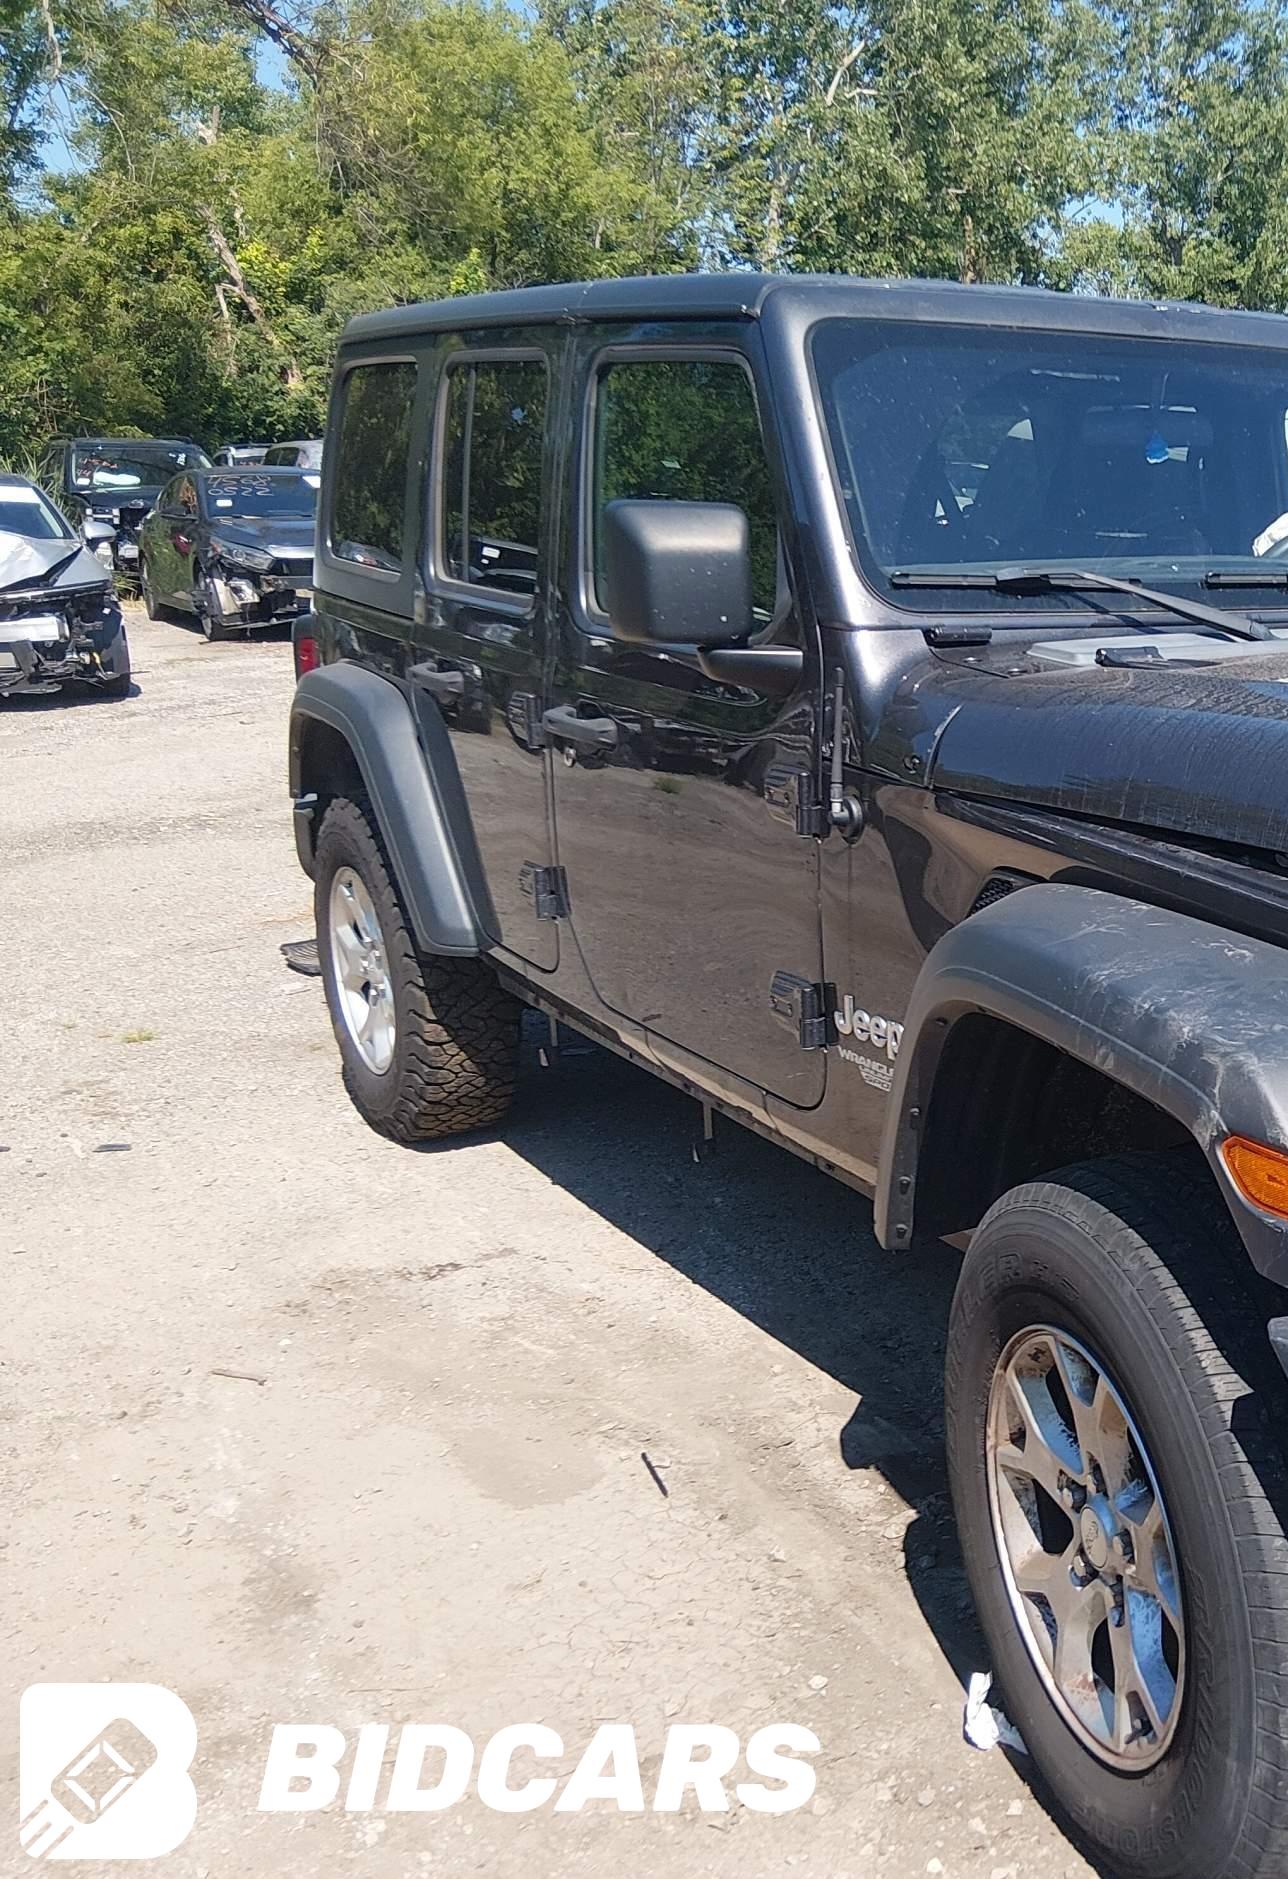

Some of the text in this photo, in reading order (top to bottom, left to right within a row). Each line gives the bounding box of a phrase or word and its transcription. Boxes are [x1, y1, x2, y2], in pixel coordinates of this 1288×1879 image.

[207, 486, 274, 497] 0522
[833, 994, 905, 1061] Jeep
[837, 1045, 895, 1077] WRANGL
